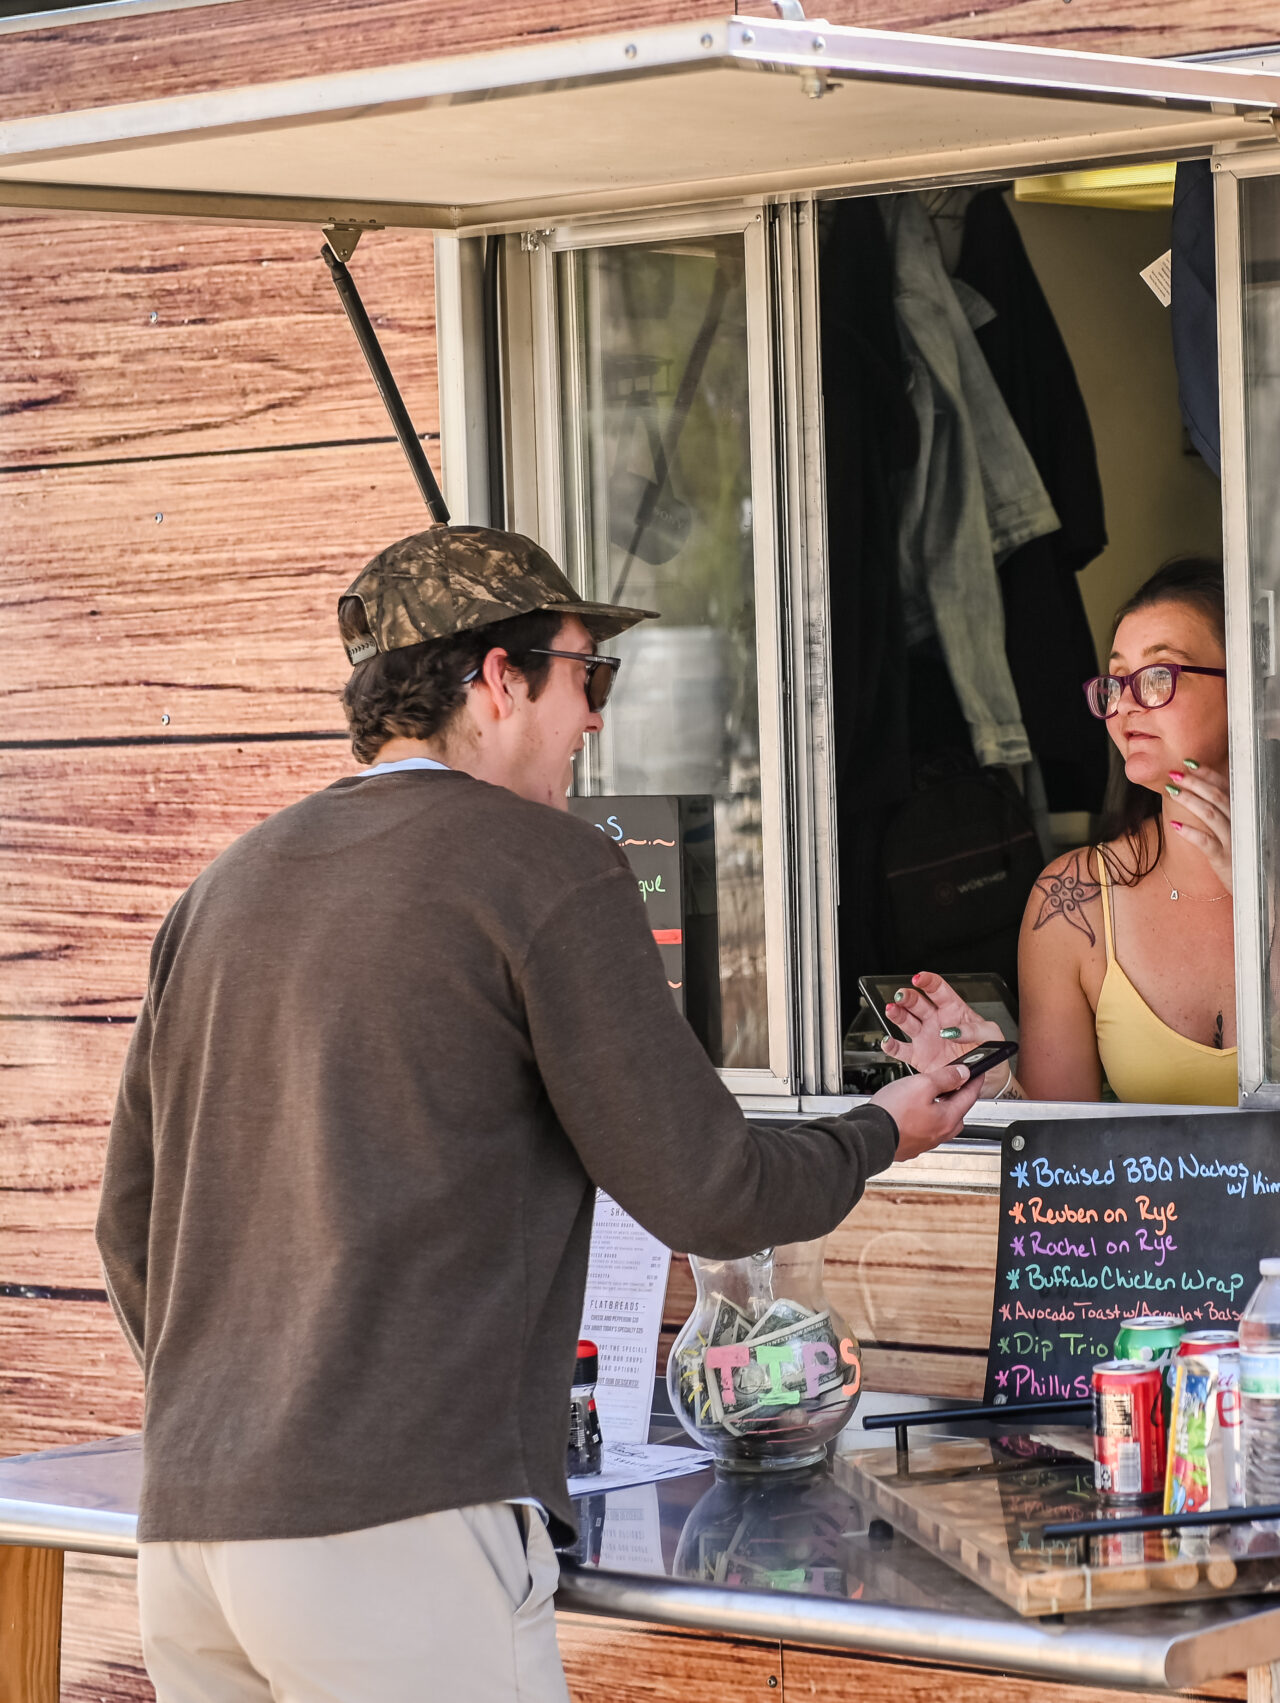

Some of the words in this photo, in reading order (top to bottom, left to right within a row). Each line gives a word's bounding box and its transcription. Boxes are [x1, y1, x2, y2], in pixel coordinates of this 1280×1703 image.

[1032, 1157, 1115, 1188] Braised
[1122, 1155, 1173, 1183] BBQ
[1178, 1153, 1250, 1180] Nachos
[1226, 1177, 1247, 1199] w/
[1028, 1196, 1099, 1224] Reuben
[1103, 1207, 1128, 1223] on
[1135, 1194, 1178, 1236] Rye
[1029, 1231, 1097, 1257] Rachel
[1106, 1240, 1130, 1254] on
[1135, 1228, 1178, 1267] Rye
[1025, 1263, 1099, 1290] Buffalo
[1101, 1265, 1176, 1290] Chicken
[1181, 1269, 1244, 1302] Wrap
[590, 1299, 639, 1311] FLATBREADS
[1015, 1300, 1076, 1321] Avocado
[1073, 1302, 1121, 1320] Toast
[622, 1345, 648, 1354] SPECIALS
[1013, 1331, 1054, 1362] Dip
[1059, 1333, 1109, 1358] Trio
[705, 1338, 860, 1406] TIPS
[1011, 1364, 1071, 1400] Philly
